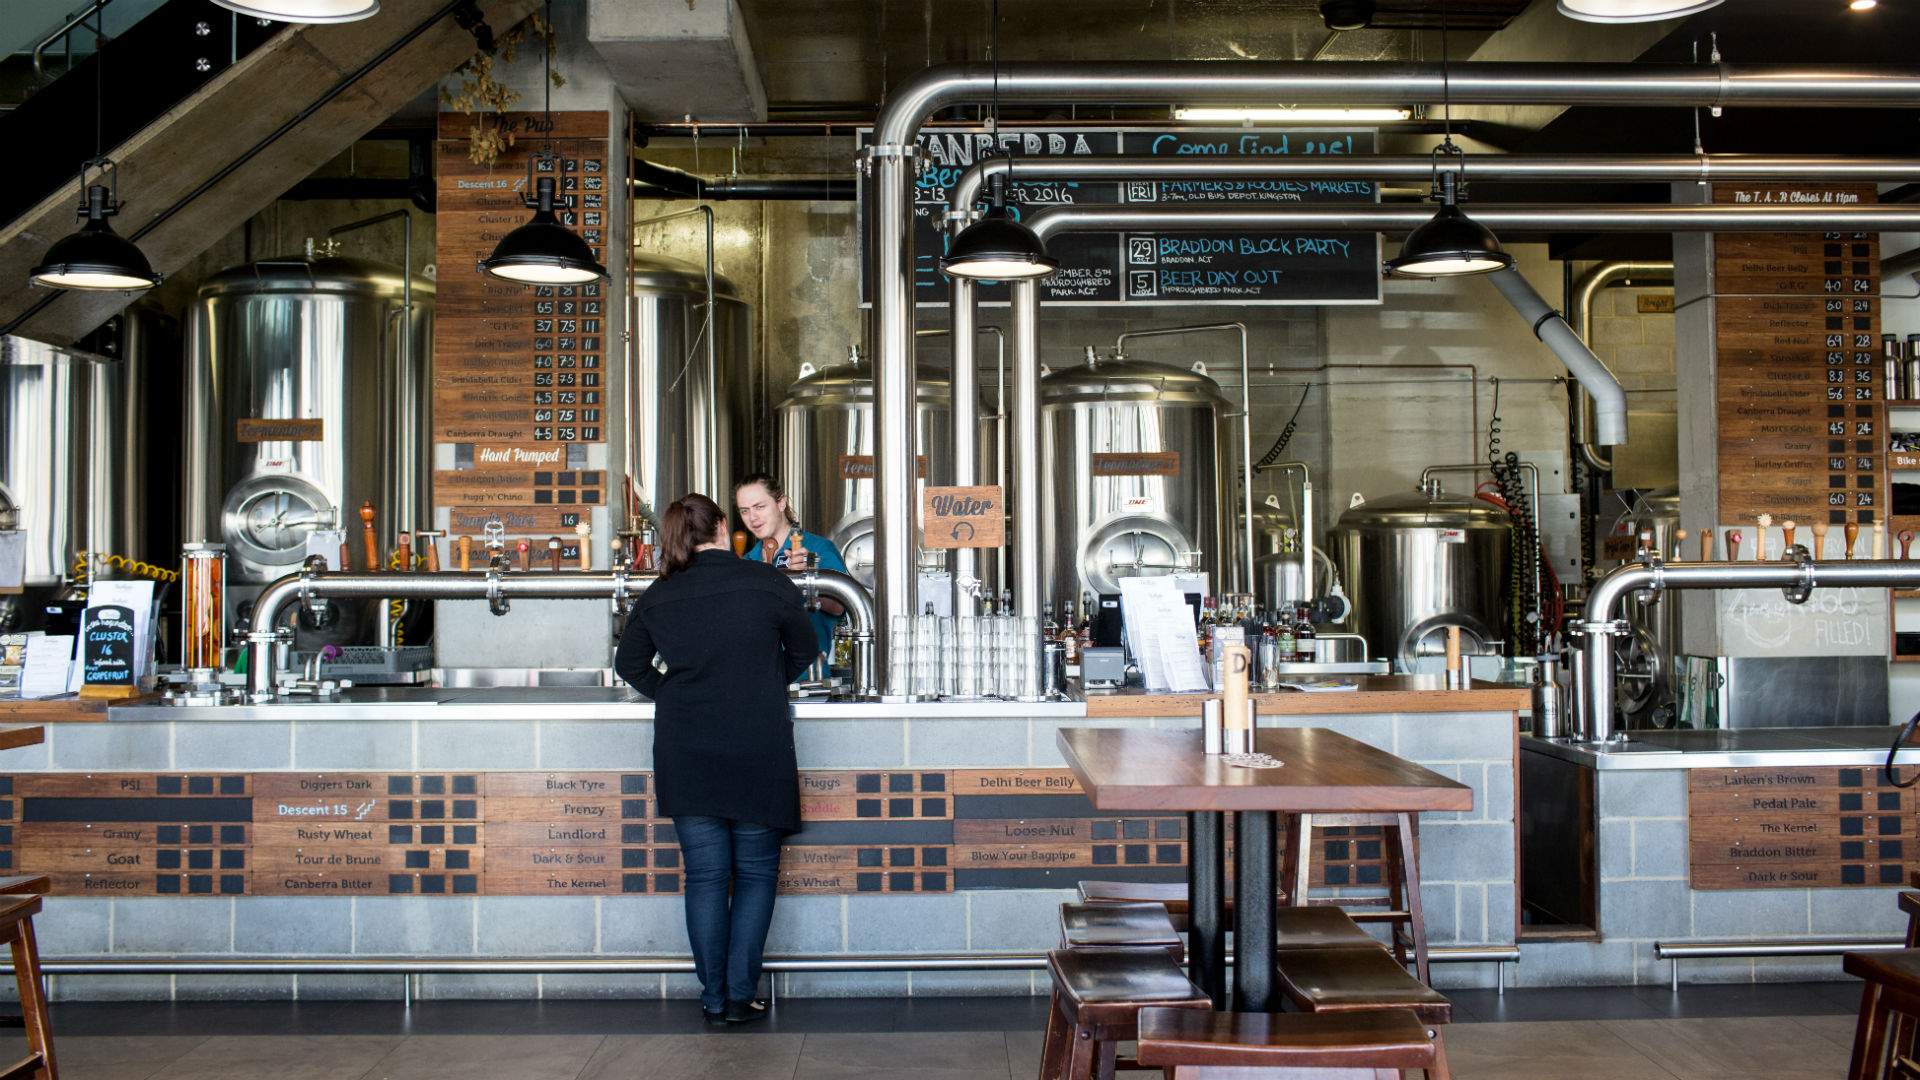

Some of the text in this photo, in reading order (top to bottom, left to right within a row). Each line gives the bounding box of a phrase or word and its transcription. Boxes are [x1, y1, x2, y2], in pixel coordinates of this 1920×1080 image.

[458, 181, 494, 189] Descent
[1310, 181, 1371, 195] MARKETS
[1035, 187, 1074, 204] 2016
[1131, 187, 1151, 199] FRI
[1207, 192, 1226, 201] BUS
[1735, 191, 1752, 203] The
[1789, 191, 1821, 203] Closes
[1821, 191, 1833, 203] At
[479, 215, 511, 224] Cluster
[1133, 241, 1152, 257] 29
[1159, 237, 1350, 259] BRADDON BLOCK PARTY
[1136, 274, 1148, 288] 5
[1160, 270, 1283, 287] BEER DAY OUT
[1854, 279, 1869, 292] 24
[564, 302, 599, 313] 8 12
[1854, 300, 1868, 311] 24
[586, 320, 595, 332] 11
[1855, 334, 1871, 347] 28
[1855, 352, 1871, 364] 28
[1856, 370, 1871, 382] 36
[1856, 387, 1871, 399] 24
[1857, 422, 1871, 435] 24
[480, 448, 560, 467] Hand Pumped
[1858, 457, 1871, 470] 24
[1896, 456, 1916, 466] Bike
[931, 494, 993, 517] Water
[1858, 493, 1872, 506] 24
[563, 515, 575, 525] 16
[563, 547, 577, 557] 26
[89, 631, 128, 643] CLUSTER
[101, 644, 113, 656] 16
[120, 780, 141, 791] PSI
[300, 779, 373, 792] Diggers Dark
[546, 779, 606, 792] Black Tyre
[803, 777, 841, 789] Fuggs
[980, 777, 1075, 789] Delhi Beer Belly
[1724, 774, 1817, 786] Larken's Brown
[277, 804, 348, 816] Descent 15
[1752, 798, 1818, 810] Pedal Pale
[563, 804, 606, 817] Frenzy
[1004, 825, 1075, 837] Loose Nut
[1759, 822, 1818, 833] The Kernel
[103, 830, 142, 842] Grainy
[297, 829, 373, 842] Rusty Wheat
[547, 828, 607, 841] Landlord
[971, 850, 1077, 864] Blow Your Bagpipe
[1729, 846, 1818, 858] Braddon Bitter
[106, 854, 142, 866] Goat
[295, 854, 382, 866] Tour de Brune
[532, 853, 606, 865] Dark & Sour
[803, 852, 842, 865] Water
[802, 877, 841, 888] Wheat
[1748, 871, 1819, 882] Dark & Sour
[84, 878, 142, 890] Reflector
[284, 879, 374, 890] Canberra Bitter
[546, 879, 608, 890] The Kernel
